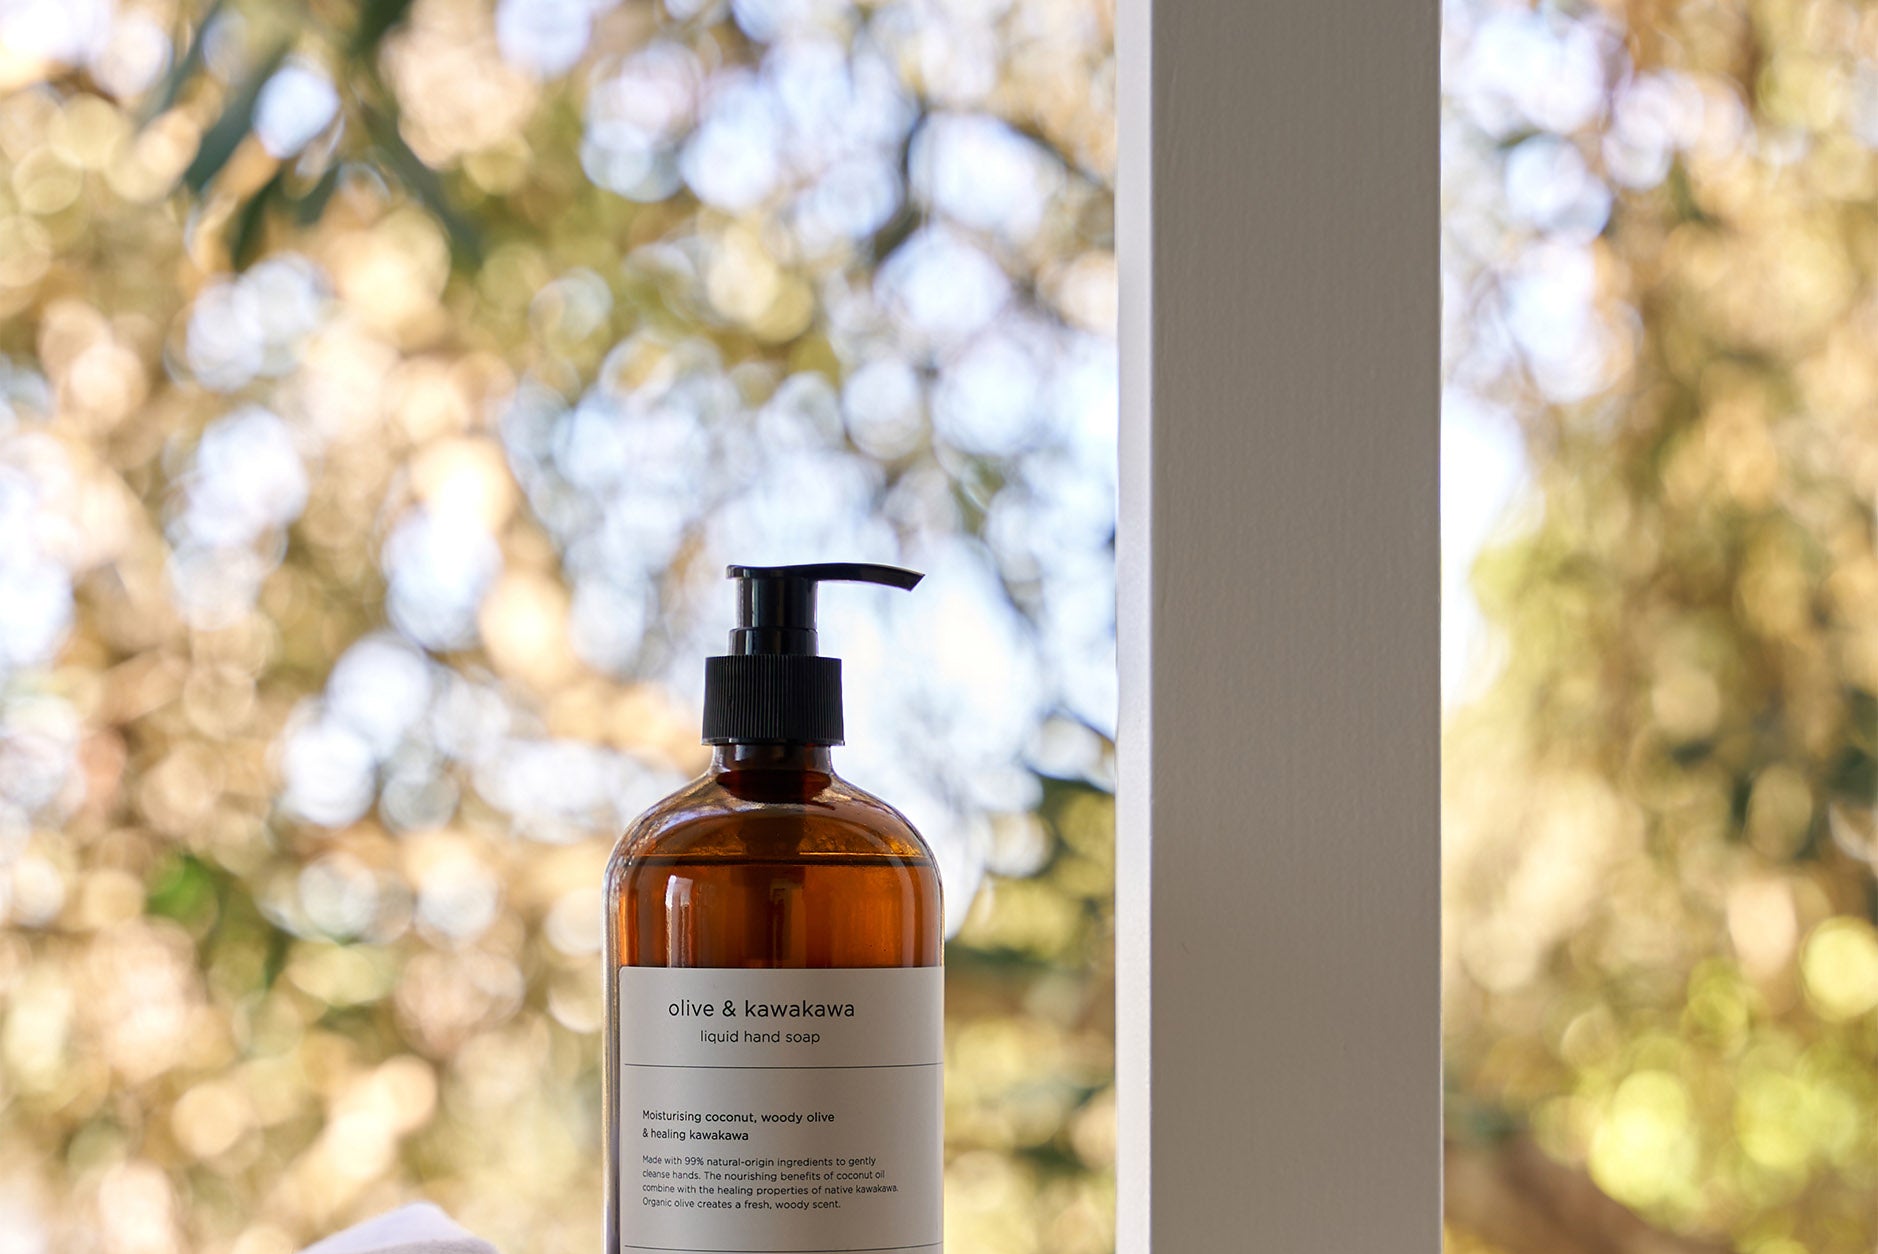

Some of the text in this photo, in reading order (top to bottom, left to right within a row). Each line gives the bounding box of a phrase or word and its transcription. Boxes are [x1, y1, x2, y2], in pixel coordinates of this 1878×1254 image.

[669, 999, 854, 1017] olive & kawakawa
[701, 1030, 820, 1044] liquid hand soap
[643, 1110, 835, 1124] Moisturising coconut, woody olive
[642, 1128, 748, 1141] & healing kawakawa
[643, 1155, 876, 1168] Made with 99% natural-origin ingredients to gently
[642, 1169, 885, 1182] cleanse hands. The nourishing benefits of coconut oil
[642, 1184, 898, 1196] combine with the healing properties of native kawakawa.
[643, 1197, 671, 1207] Organic
[674, 1199, 694, 1208] olive
[697, 1200, 732, 1209] creates
[745, 1200, 772, 1210] fresh,
[775, 1200, 809, 1210] woody
[813, 1200, 840, 1209] scent.
